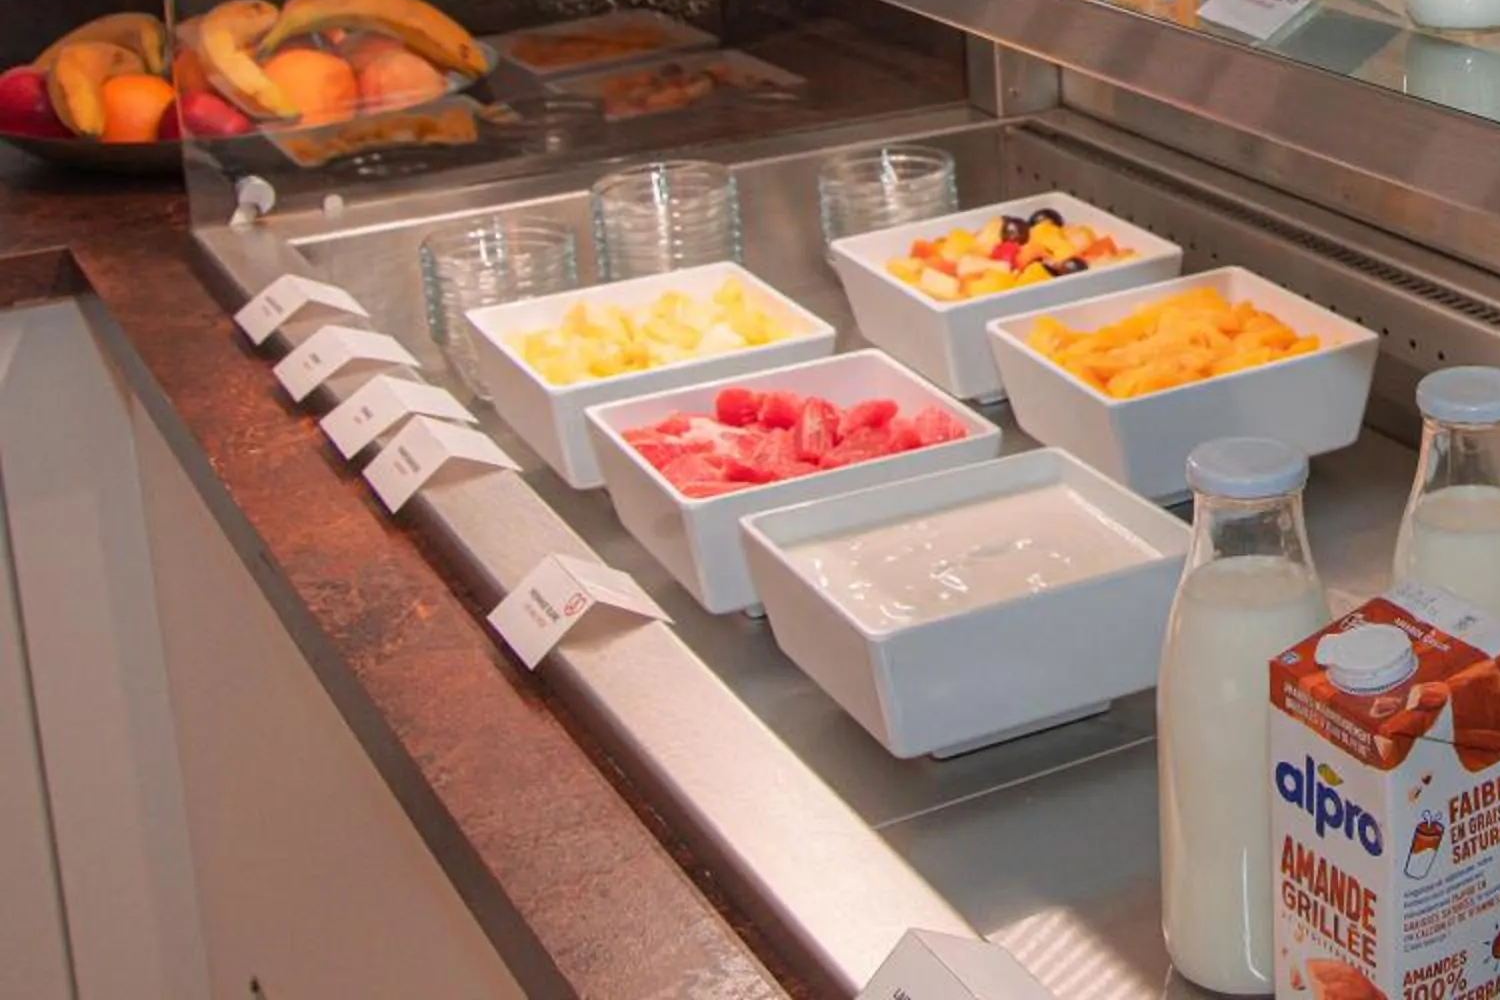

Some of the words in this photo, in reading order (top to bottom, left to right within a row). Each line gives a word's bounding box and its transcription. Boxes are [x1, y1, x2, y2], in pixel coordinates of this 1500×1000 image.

[1275, 753, 1384, 857] alpro
[1450, 821, 1466, 845] EN
[1280, 833, 1378, 936] AMANDE
[1281, 879, 1378, 968] GRILLÉE
[1403, 948, 1468, 987] AMANDES
